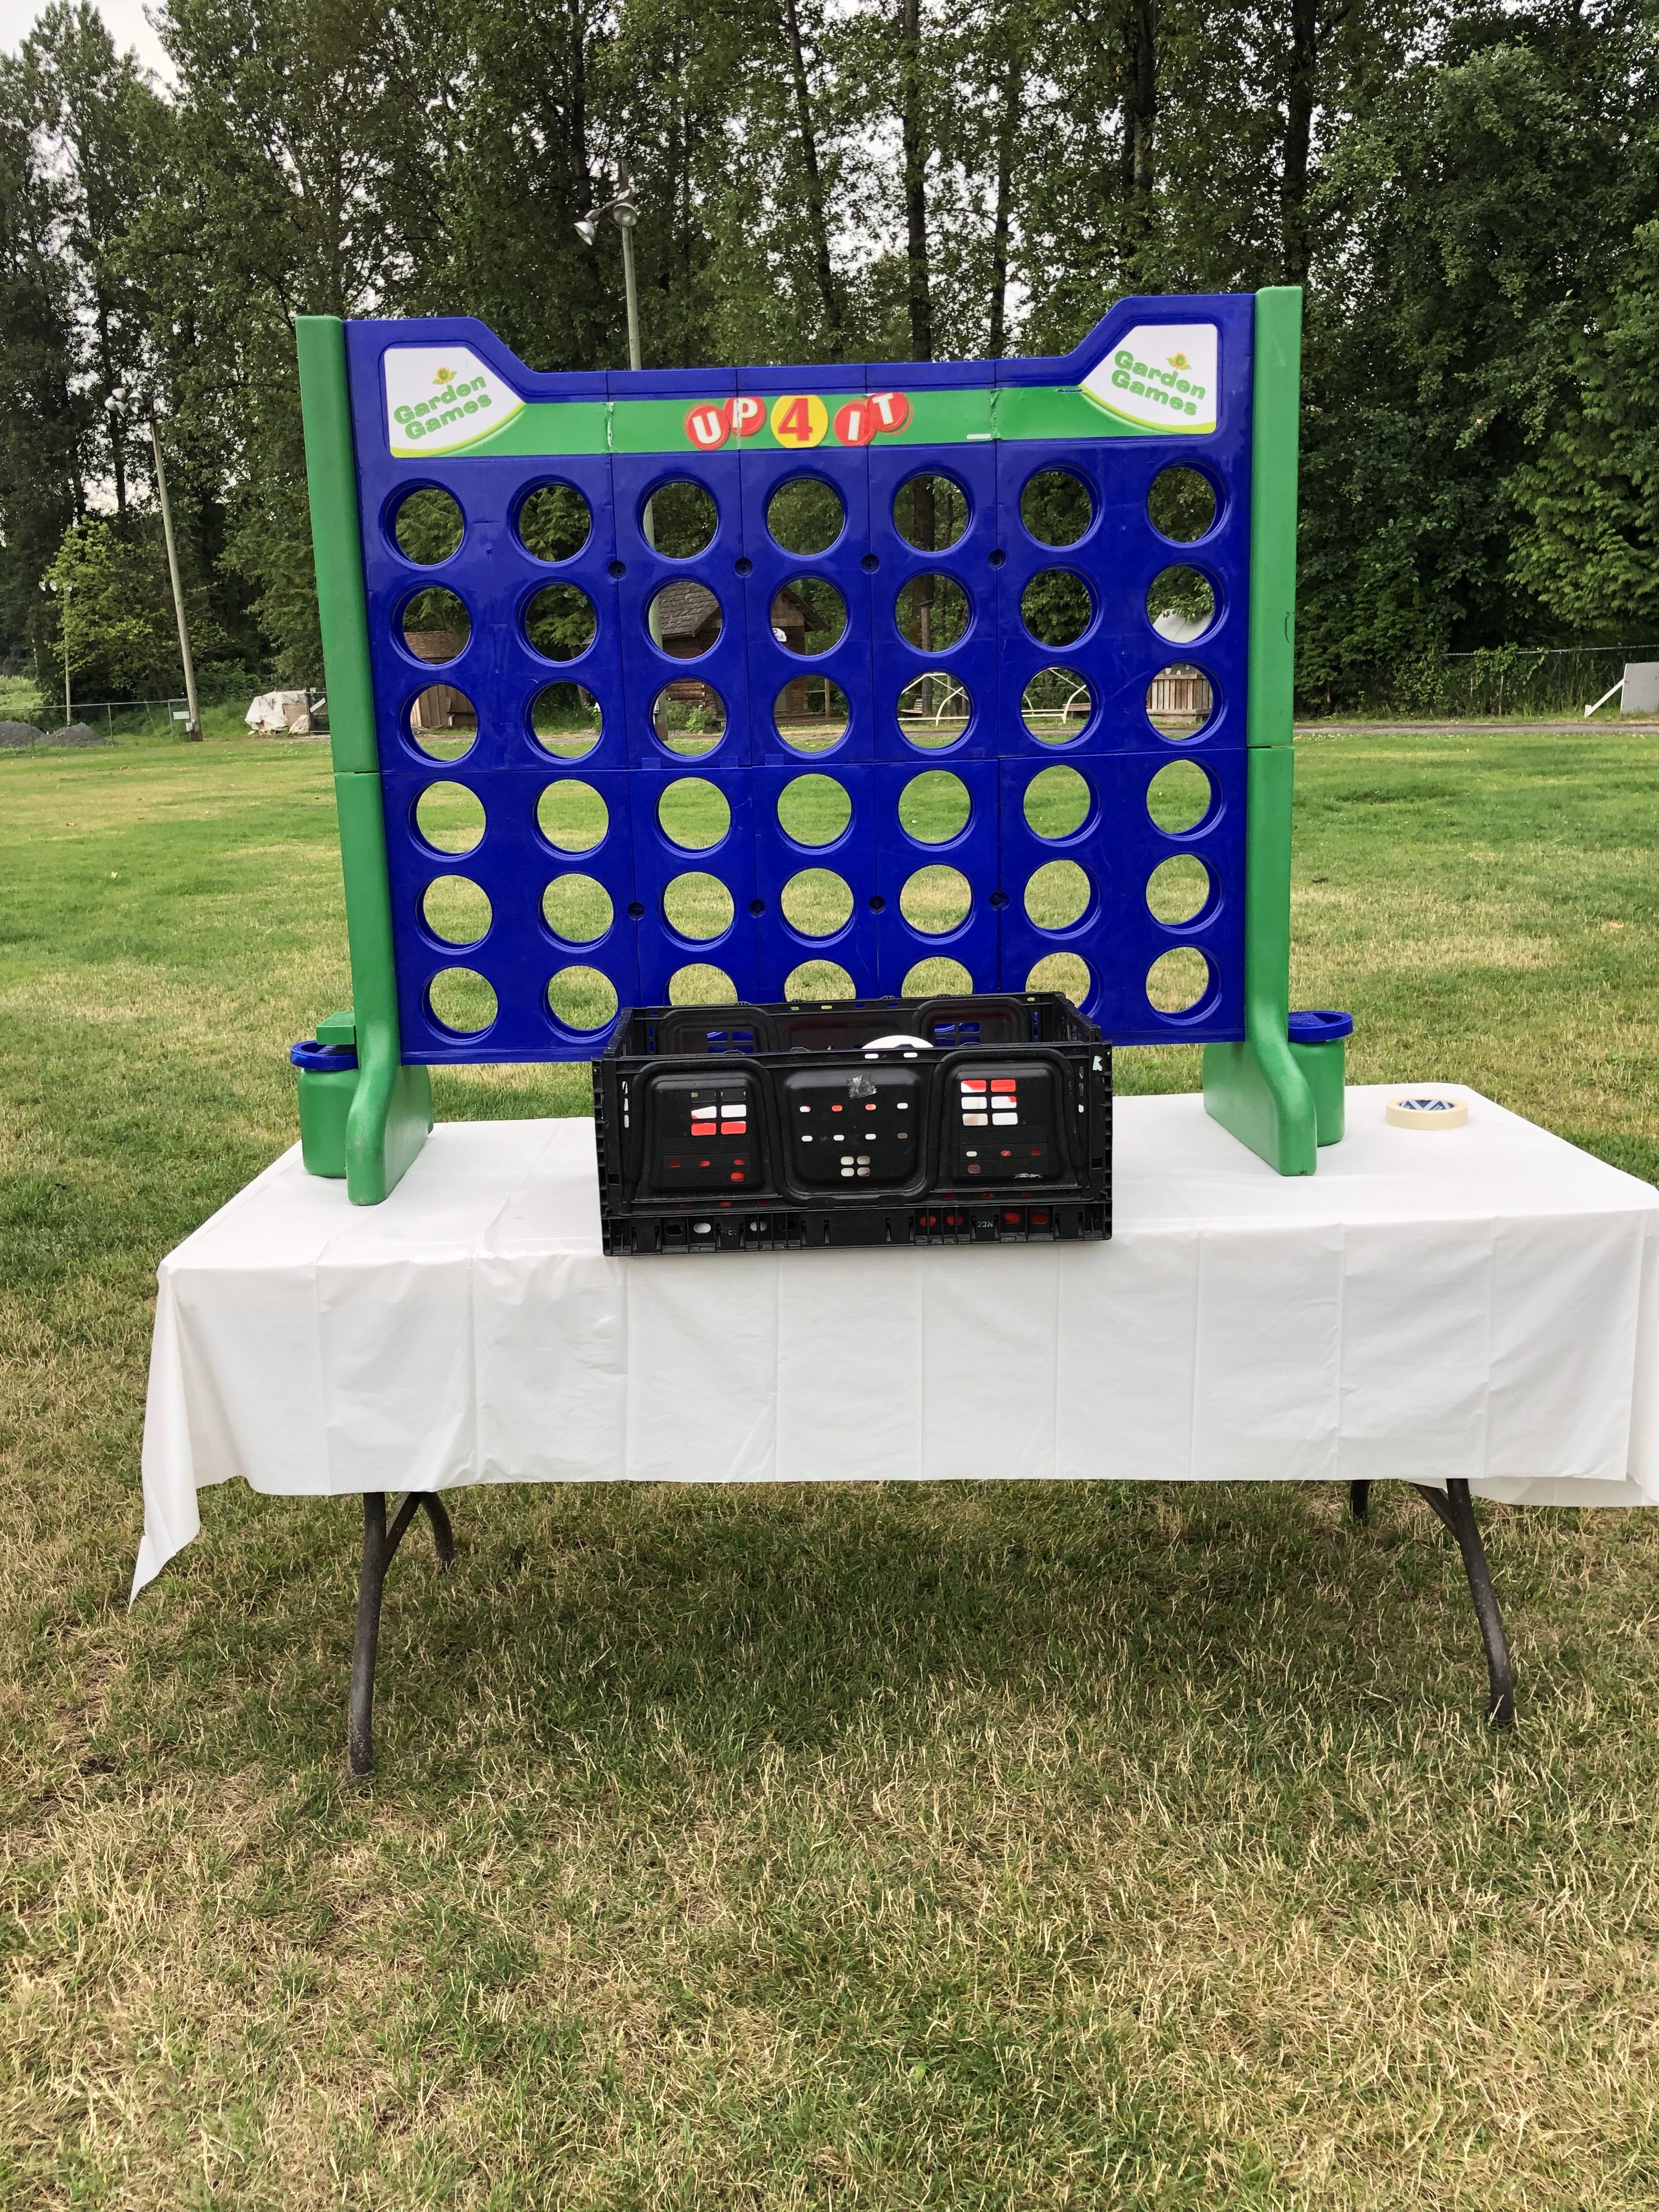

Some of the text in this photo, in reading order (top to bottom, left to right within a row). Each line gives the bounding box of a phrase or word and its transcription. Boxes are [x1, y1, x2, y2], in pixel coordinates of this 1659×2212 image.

[1111, 370, 1197, 416] Games
[1115, 351, 1206, 400] Garden
[394, 376, 487, 424] Garden
[405, 394, 492, 439] Games
[778, 398, 812, 441] 4
